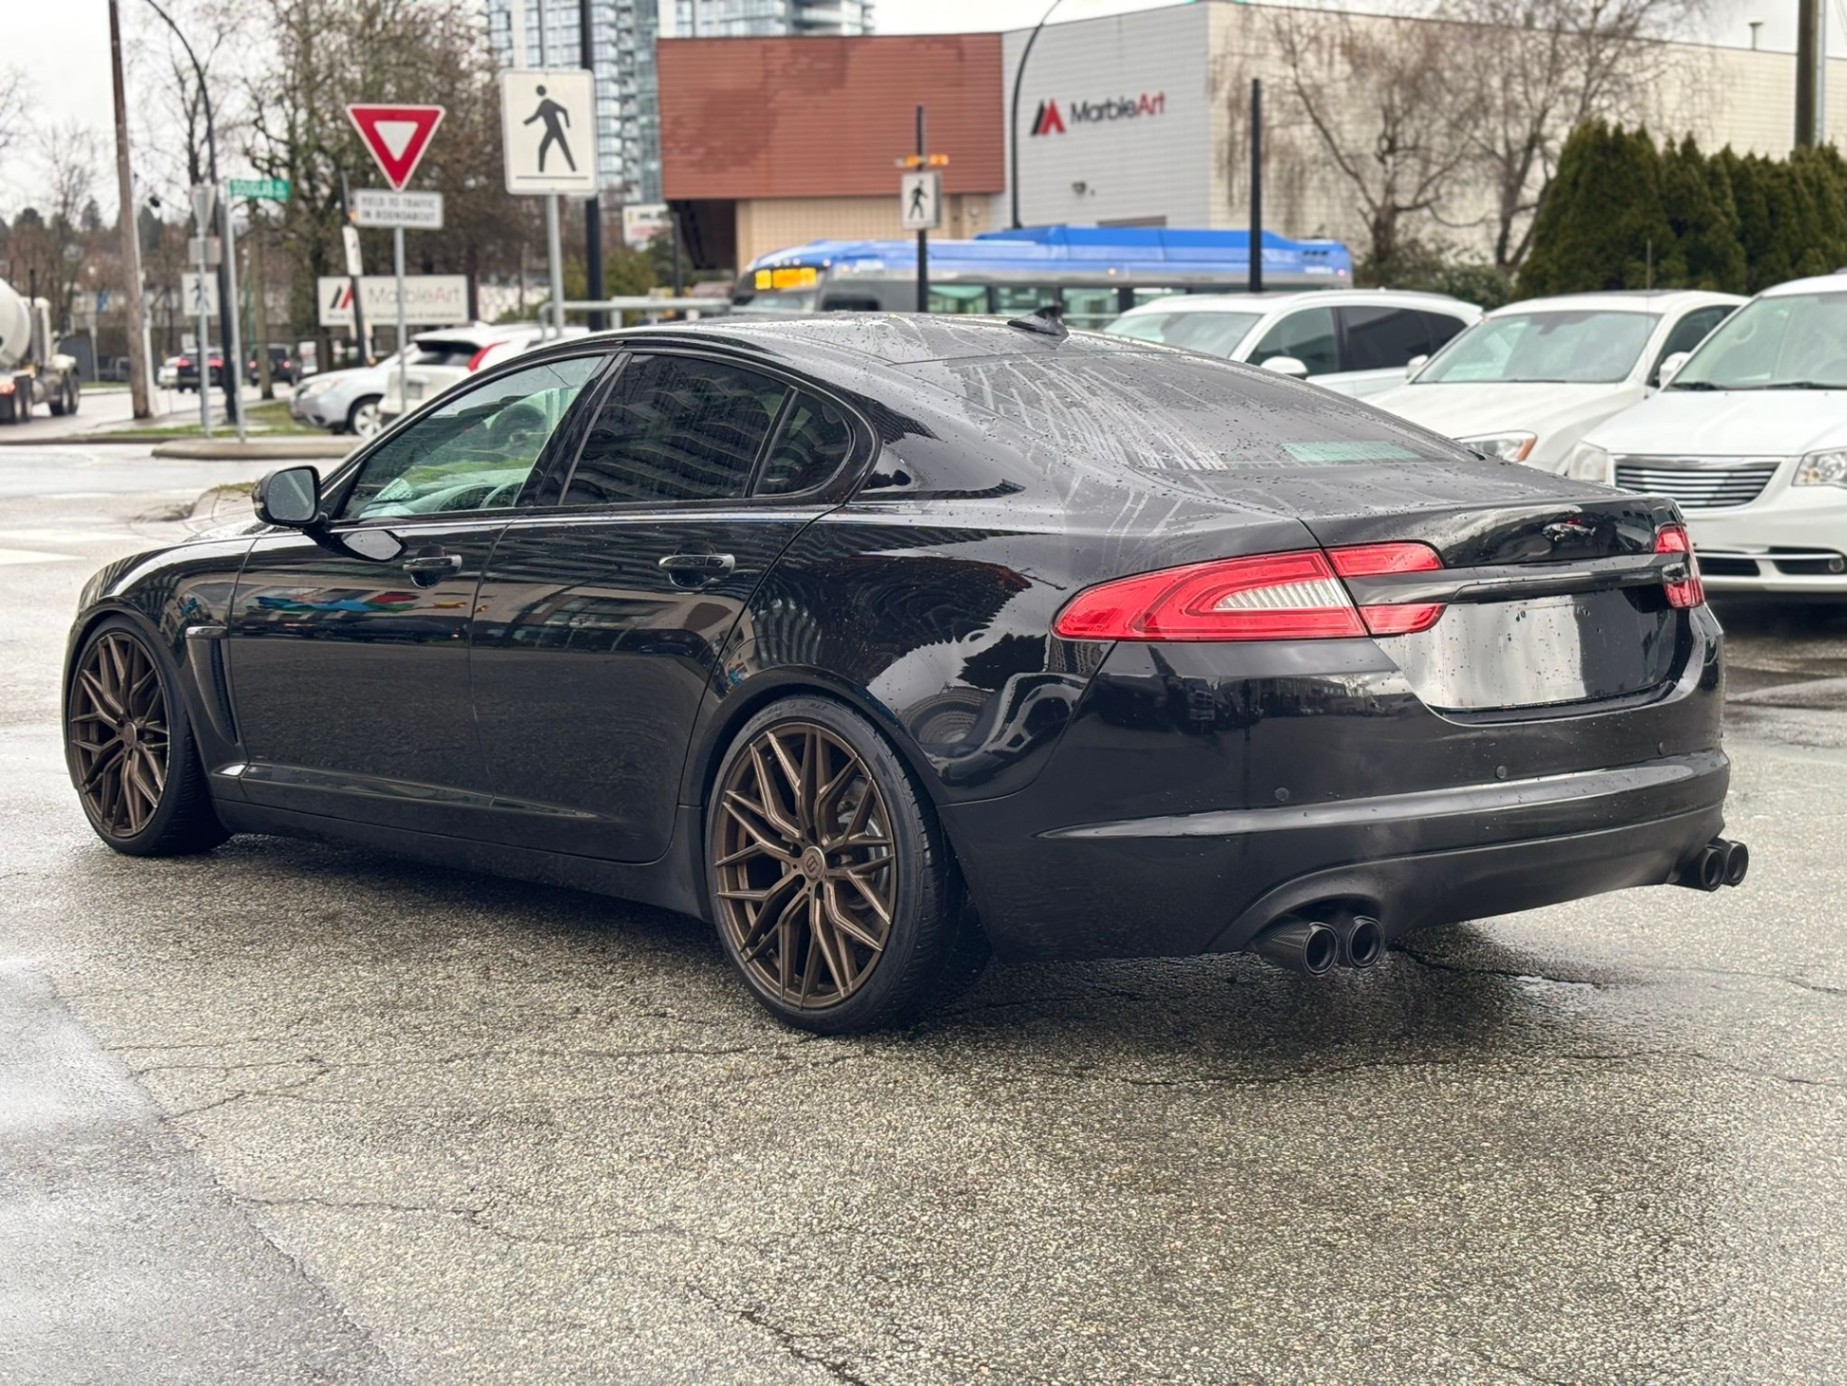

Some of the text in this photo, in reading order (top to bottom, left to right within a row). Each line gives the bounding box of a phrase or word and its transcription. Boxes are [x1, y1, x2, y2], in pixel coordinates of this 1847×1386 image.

[1070, 92, 1165, 124] MarbleArt
[361, 197, 436, 209] YIELD TO TRAFFIC
[362, 210, 436, 221] IN ROUNDABOUT
[368, 286, 460, 304] MableArt
